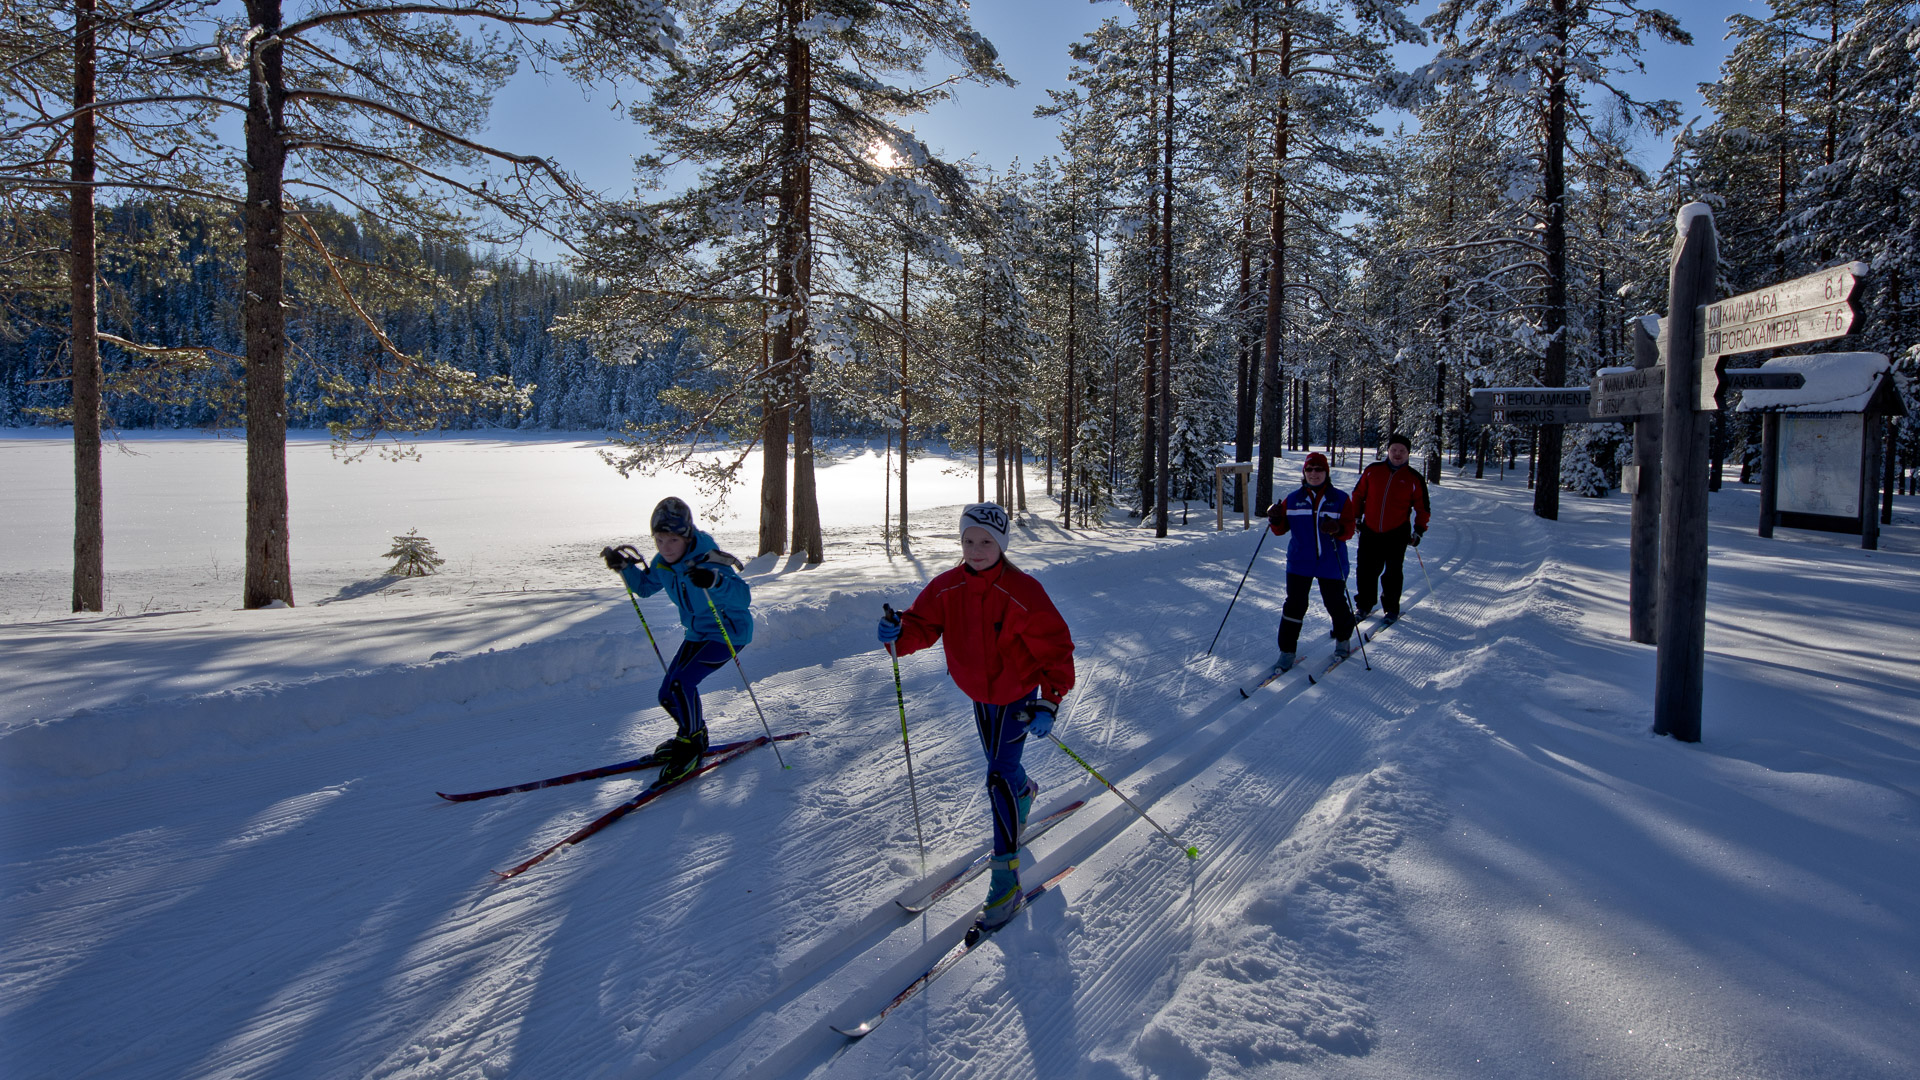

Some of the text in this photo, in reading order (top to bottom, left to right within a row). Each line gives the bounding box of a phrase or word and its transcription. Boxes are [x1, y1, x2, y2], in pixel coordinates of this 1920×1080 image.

[1721, 275, 1843, 323] KIVIVAARA 6.1
[1721, 308, 1843, 351] POROKÄMPPÄ 7.6
[1783, 375, 1800, 388] 7.3
[1506, 409, 1555, 422] KESKUS
